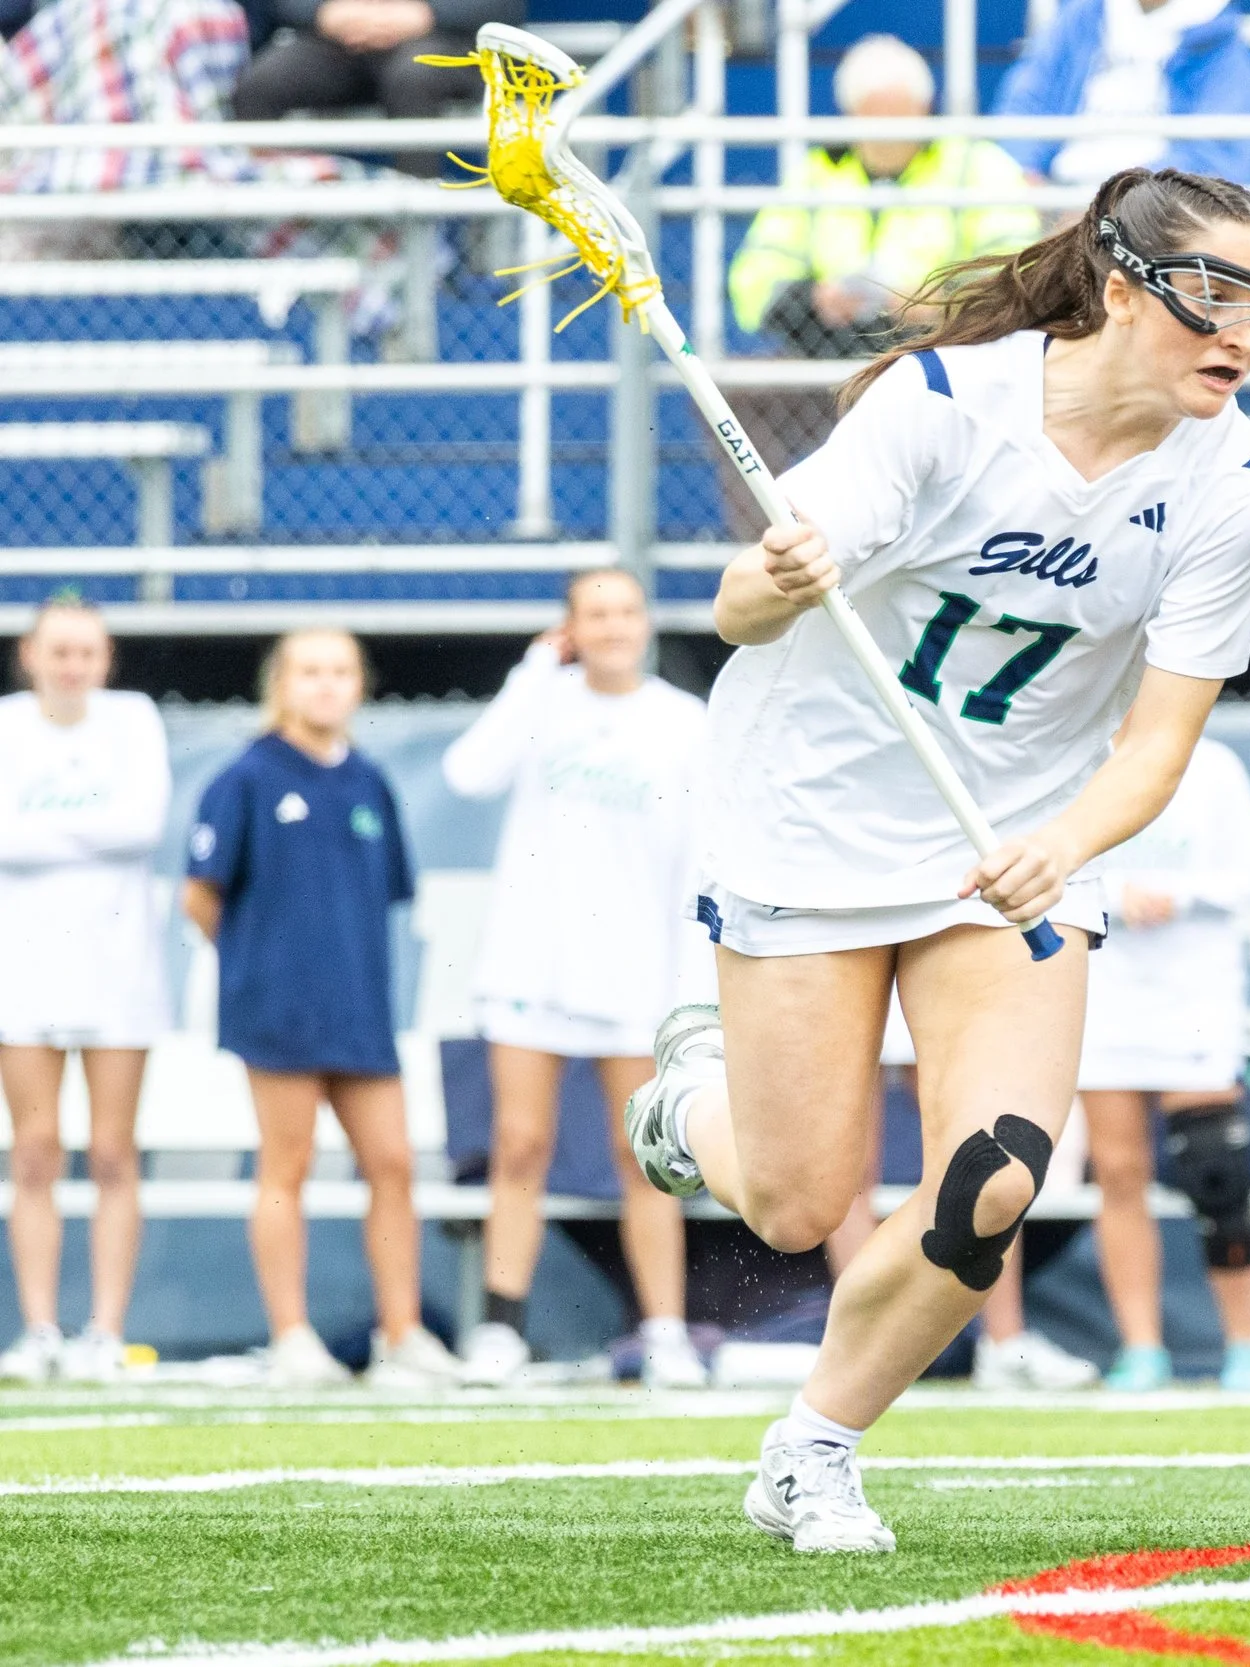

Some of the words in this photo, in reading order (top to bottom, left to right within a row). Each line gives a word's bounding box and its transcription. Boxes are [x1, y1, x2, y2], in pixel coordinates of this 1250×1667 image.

[1112, 243, 1153, 279] STX
[718, 420, 762, 474] GAIT
[898, 591, 1082, 726] 17
